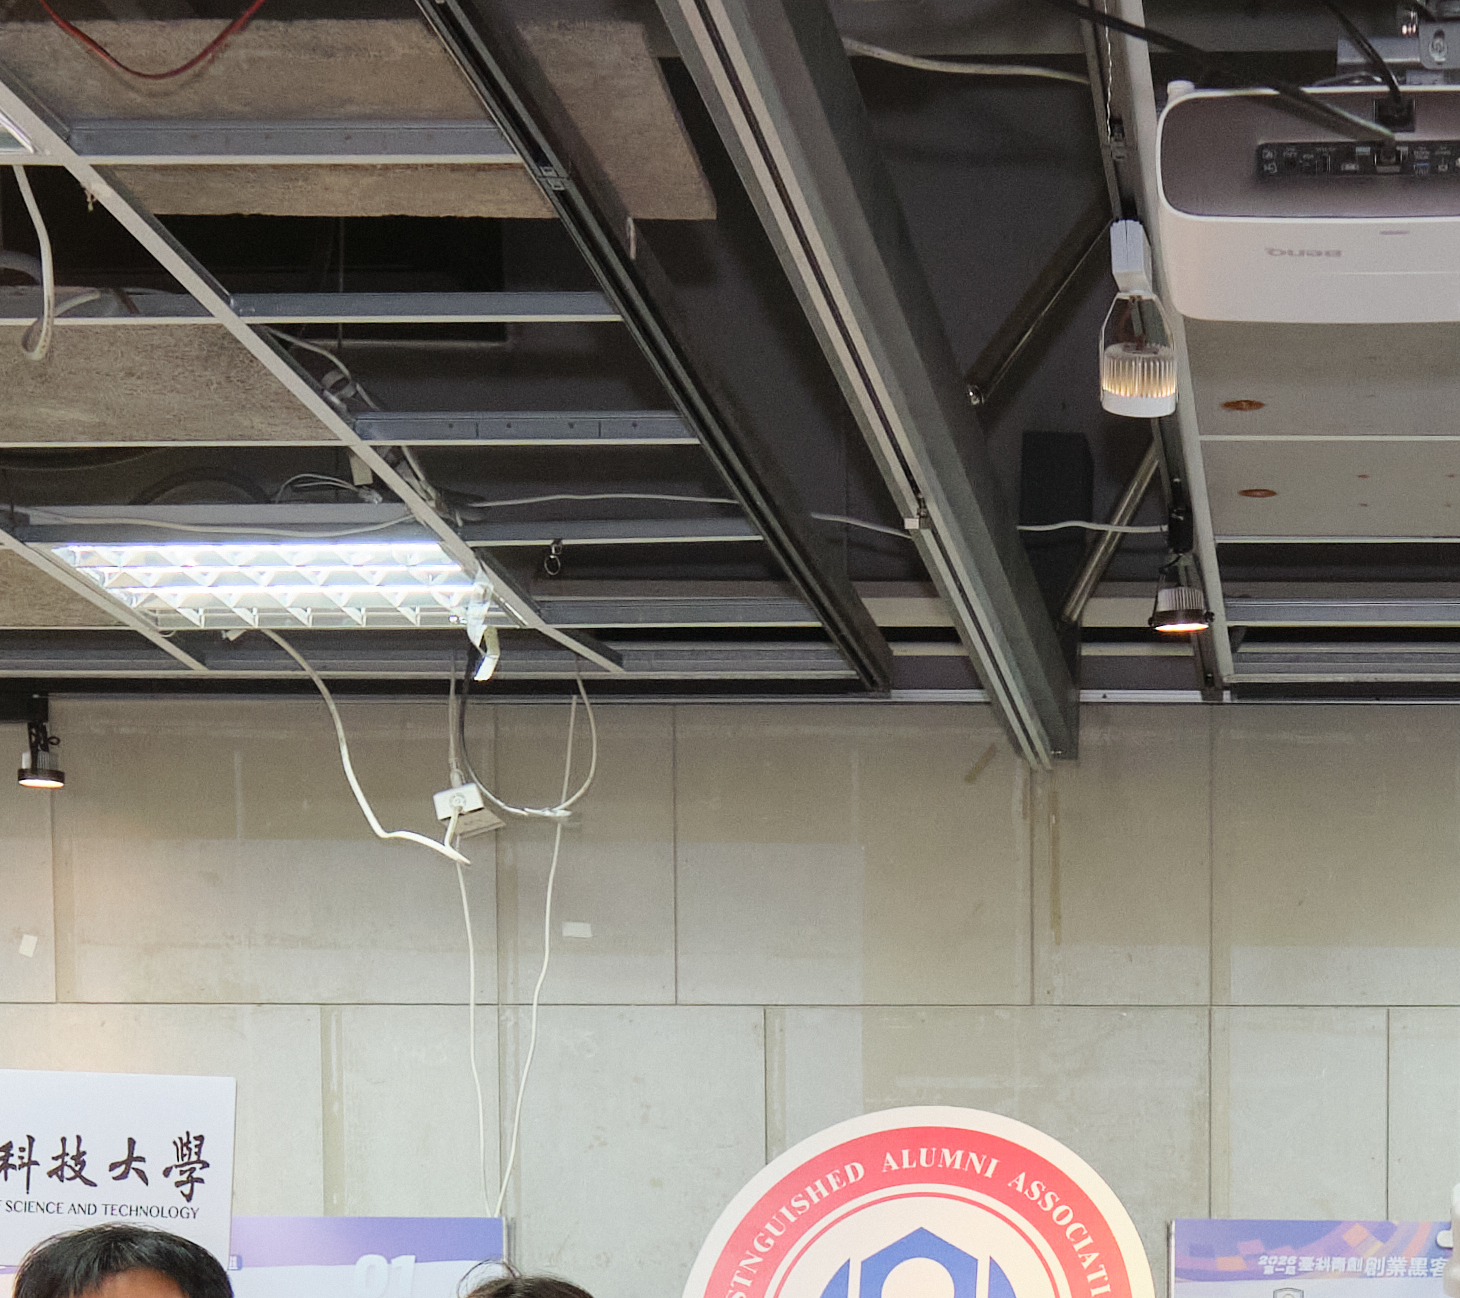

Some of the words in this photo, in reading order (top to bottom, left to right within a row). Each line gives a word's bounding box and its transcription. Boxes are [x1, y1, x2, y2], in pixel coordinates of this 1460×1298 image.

[881, 1147, 1000, 1179] ALUMNI
[5, 1200, 64, 1215] SCIENCE
[67, 1202, 98, 1216] AND
[102, 1203, 200, 1220] TECHNOLOGY
[1258, 1255, 1298, 1266] 2026
[1365, 1255, 1448, 1278] 創業黑客
